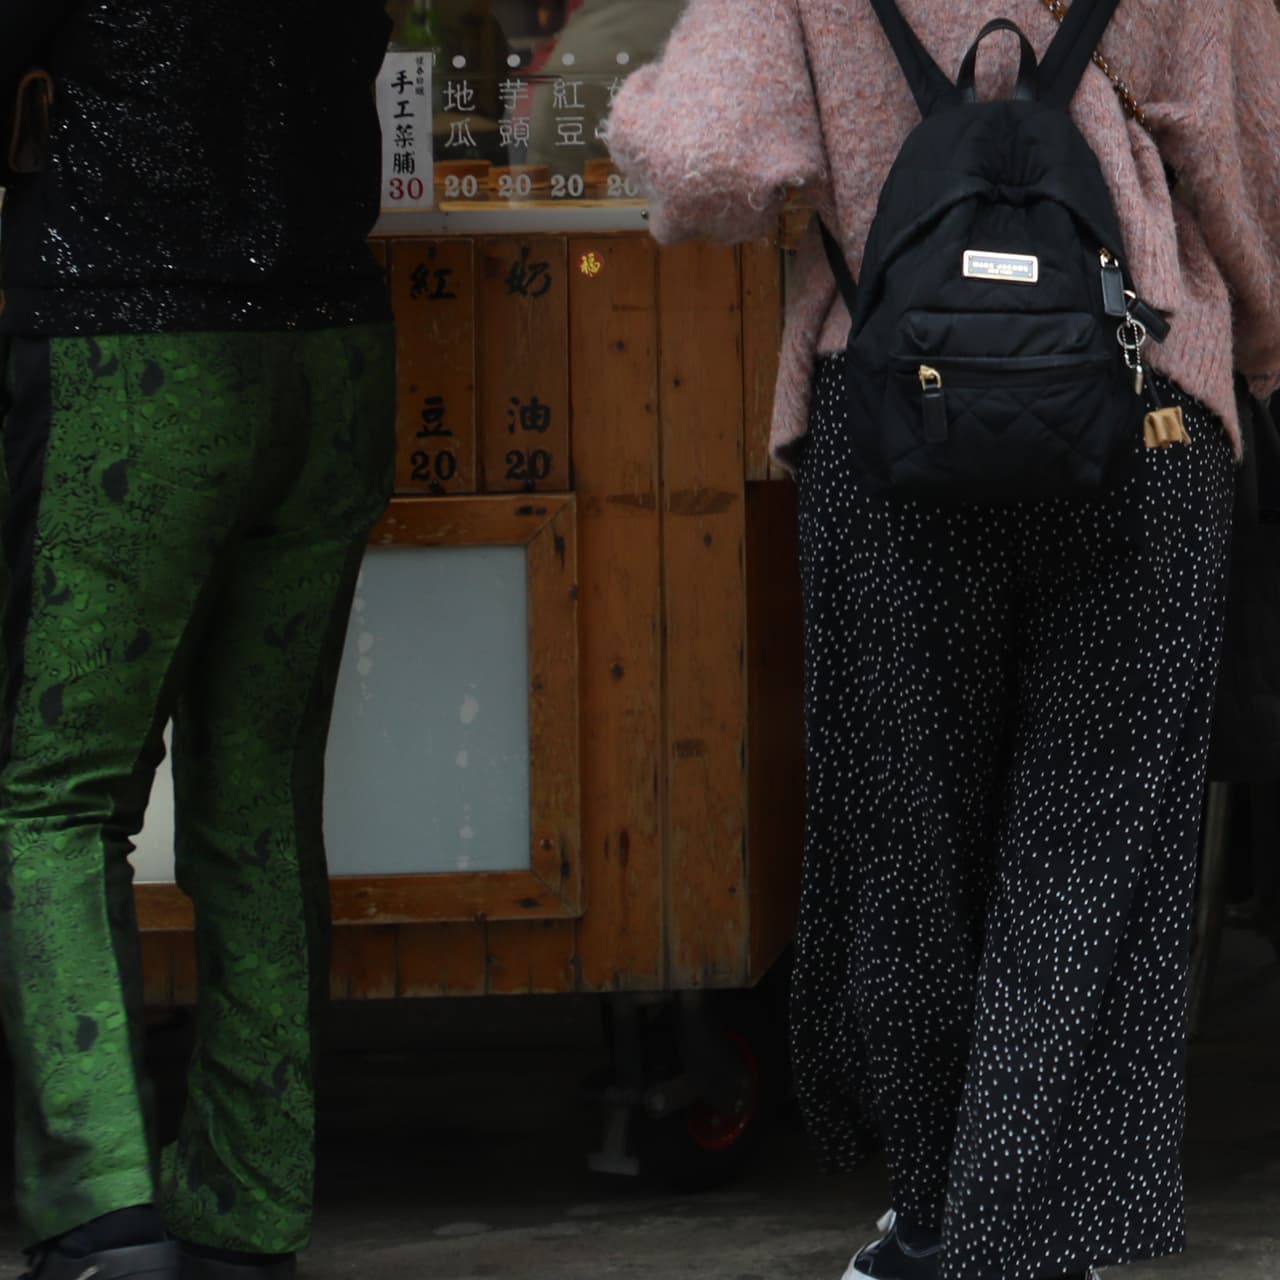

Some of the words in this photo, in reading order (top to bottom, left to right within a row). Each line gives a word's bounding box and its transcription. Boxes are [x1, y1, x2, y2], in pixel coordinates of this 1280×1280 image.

[391, 70, 415, 174] 手工菜脯
[443, 80, 477, 148] 地瓜
[499, 79, 530, 148] 芋頭
[553, 80, 586, 146] 紅豆
[389, 177, 424, 200] 30
[444, 175, 478, 197] 20
[499, 175, 532, 197] 20
[551, 175, 584, 197] 20
[411, 450, 456, 481] 20
[505, 449, 552, 481] 20
